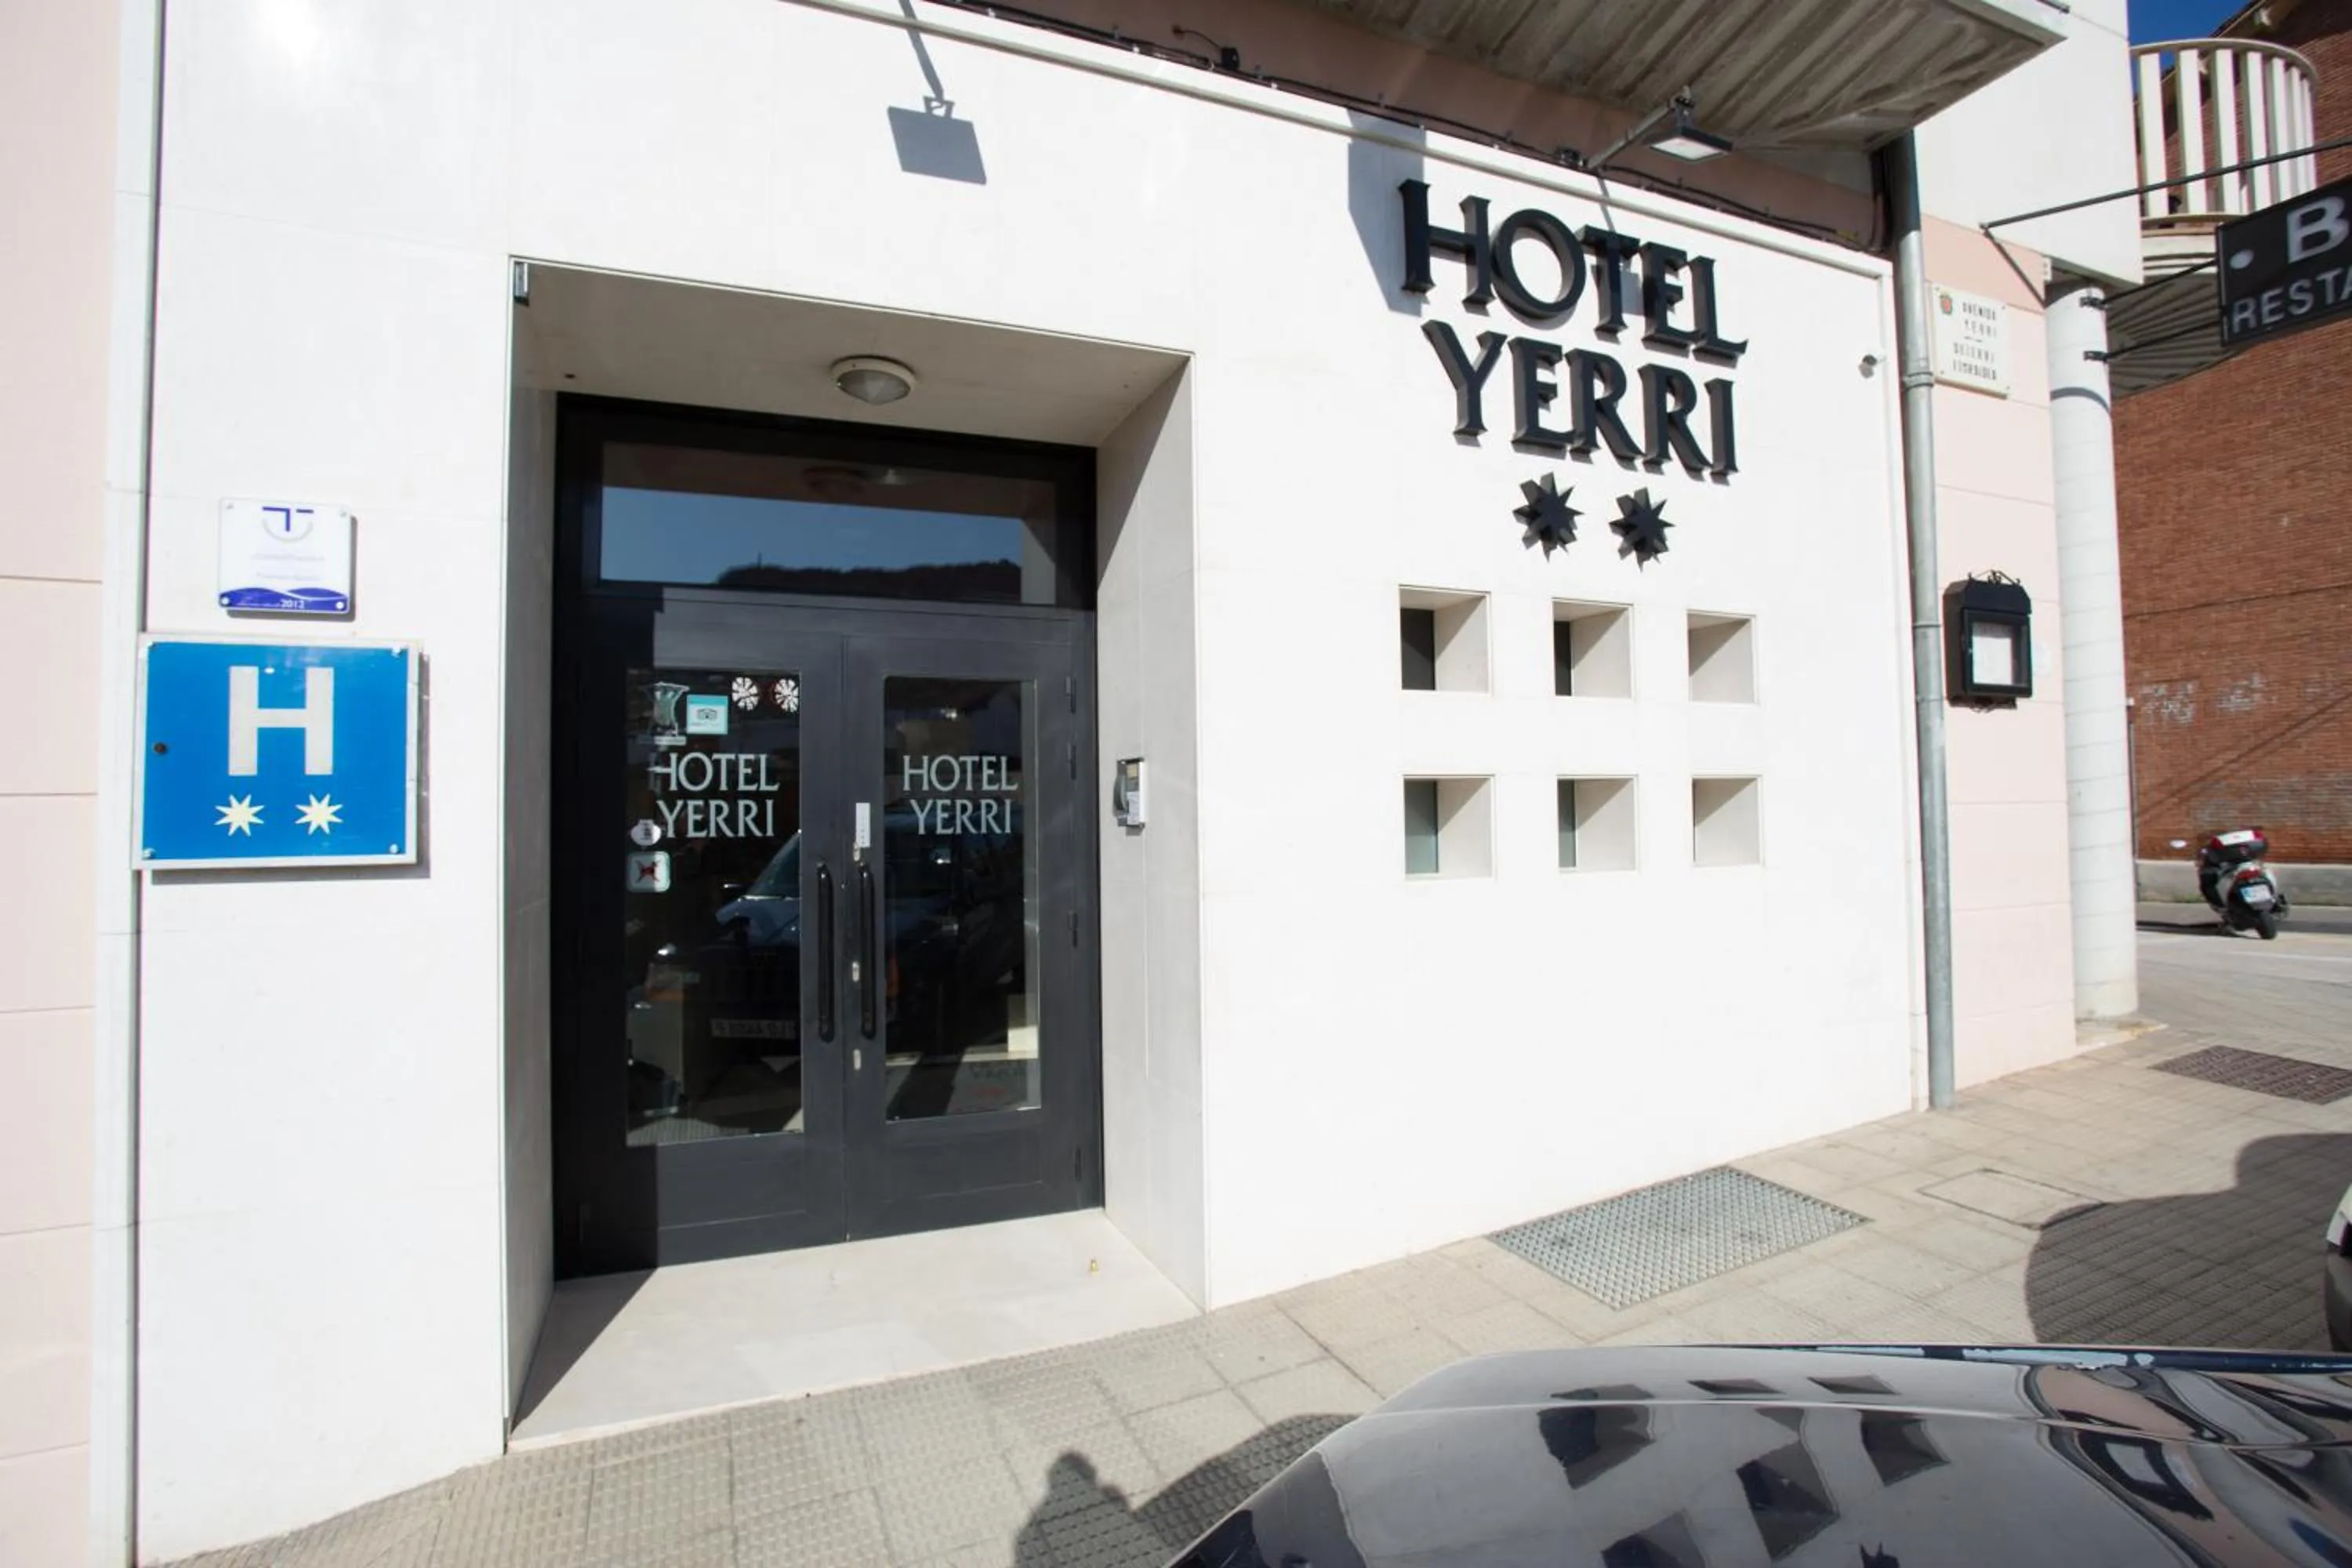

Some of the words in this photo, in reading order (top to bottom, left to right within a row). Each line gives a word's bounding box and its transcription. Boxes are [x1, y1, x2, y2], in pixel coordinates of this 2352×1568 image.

[1397, 178, 1748, 362] HOTEL
[1421, 318, 1740, 480] YERRI
[228, 666, 334, 776] H
[648, 752, 780, 792] HOTEL
[902, 754, 1018, 792] HOTEL
[655, 799, 775, 838] YERRI
[909, 798, 1012, 835] YERRI
